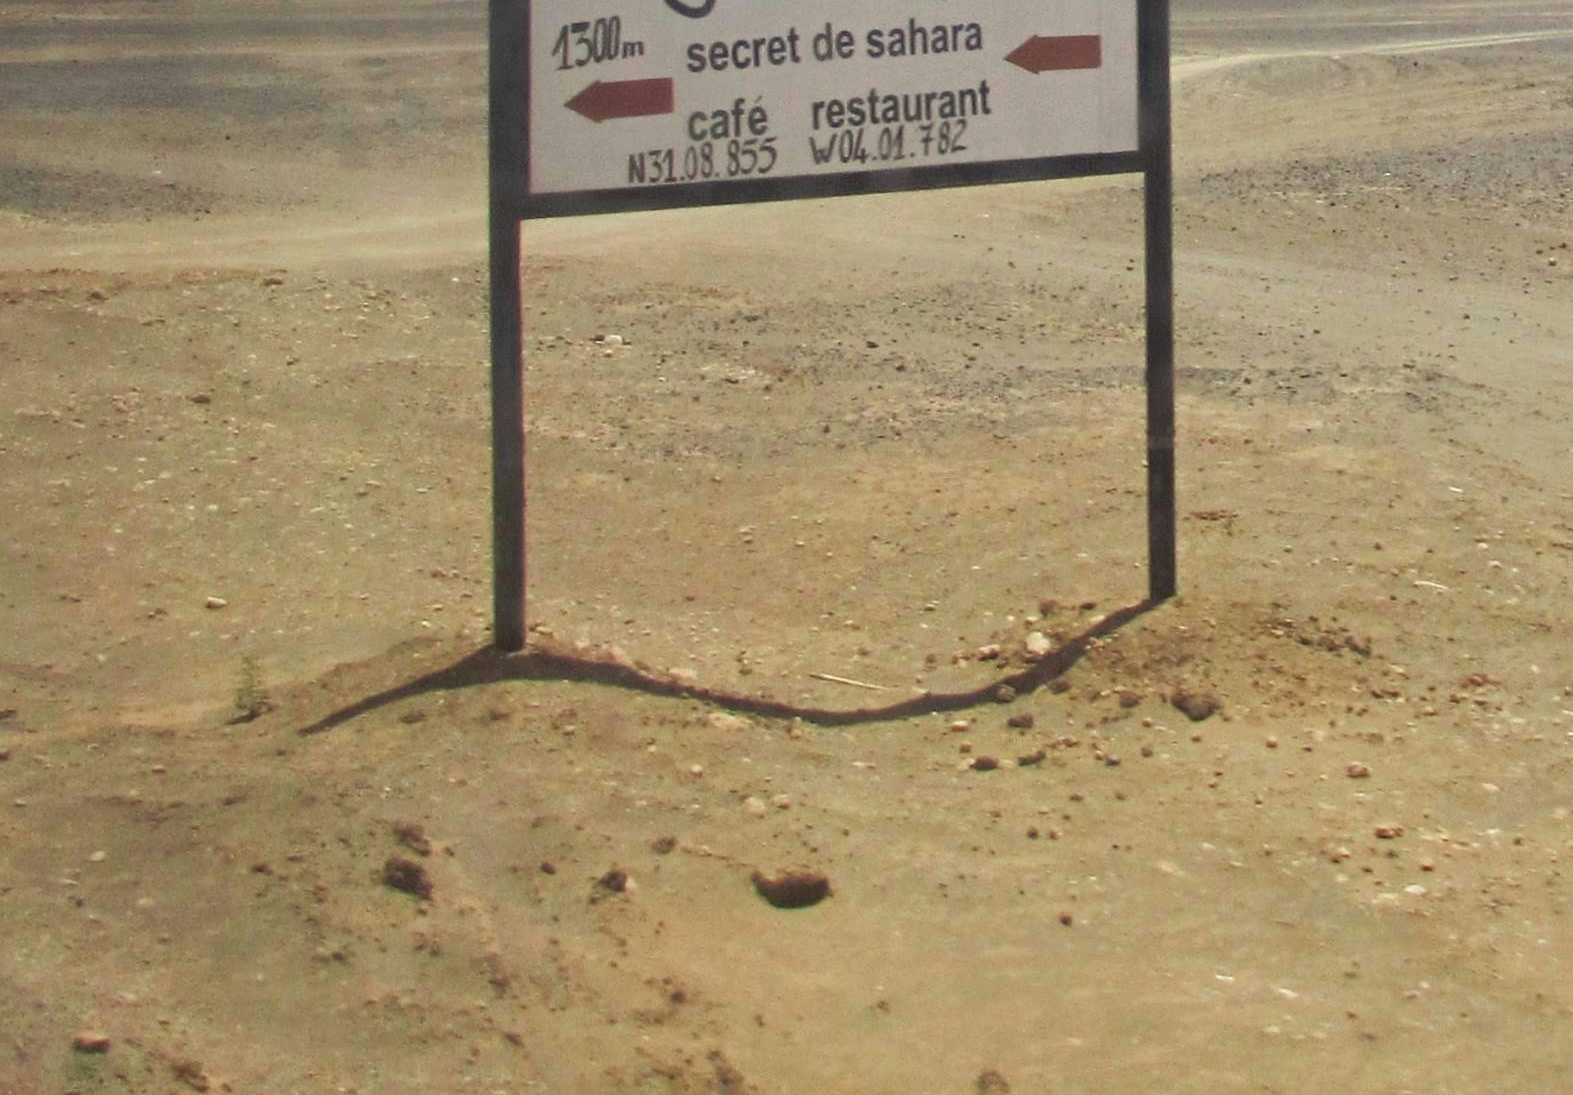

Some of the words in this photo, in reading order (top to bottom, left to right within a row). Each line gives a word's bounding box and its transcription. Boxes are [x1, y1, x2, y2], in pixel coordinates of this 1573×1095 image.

[551, 15, 645, 71] 1300m
[687, 27, 801, 73] secret
[812, 22, 855, 61] de
[866, 17, 983, 59] sahara
[687, 95, 769, 142] café
[812, 80, 992, 131] restaurant
